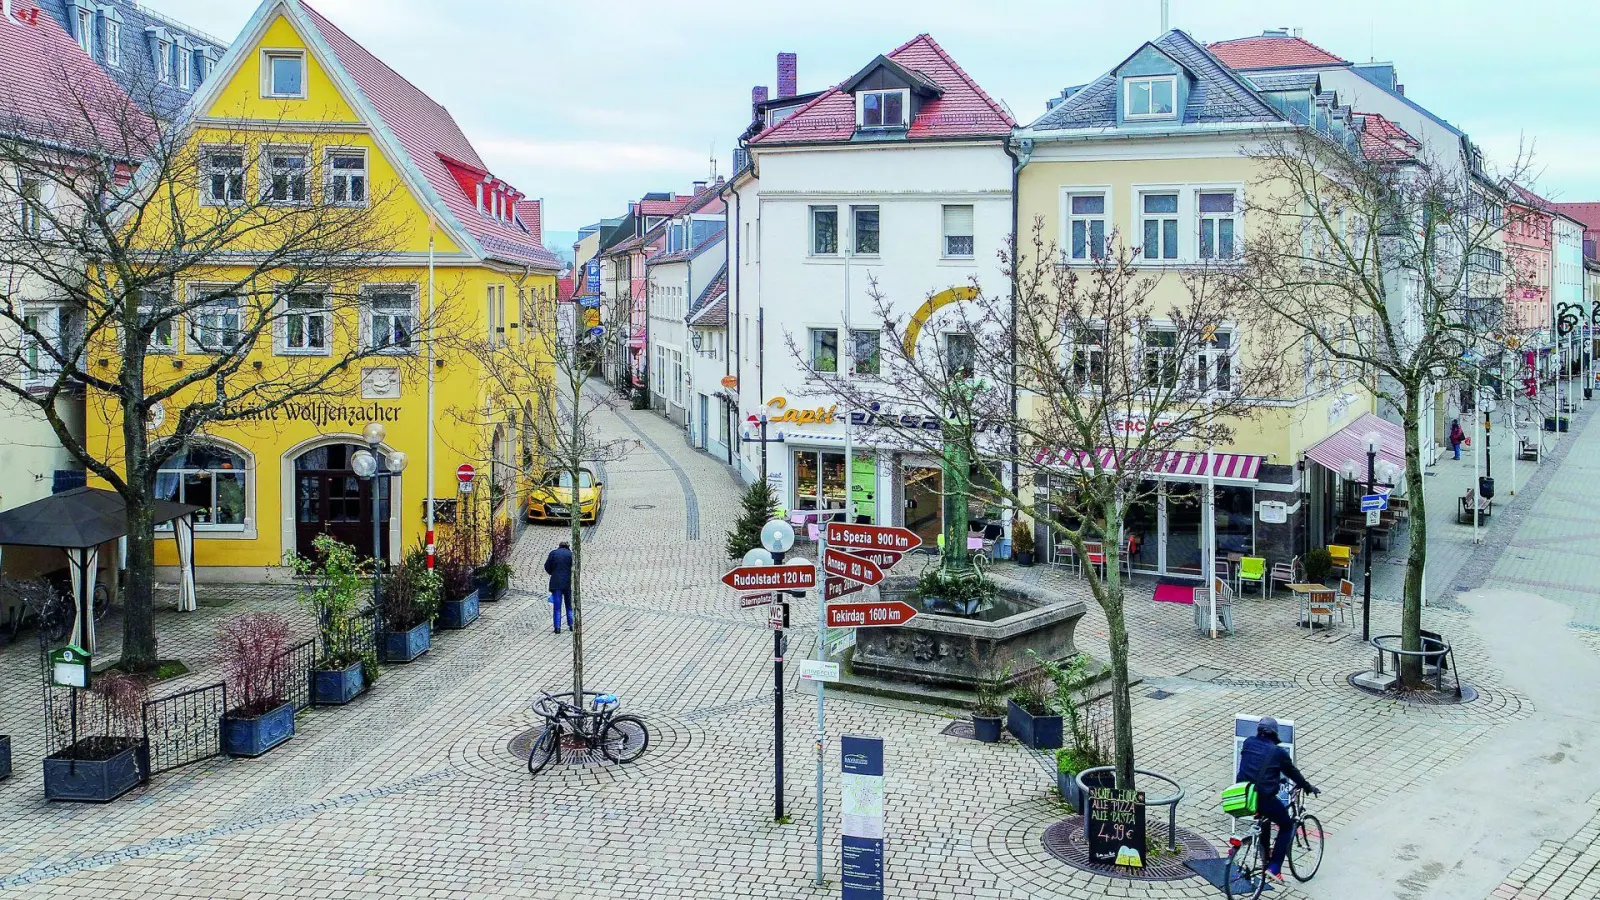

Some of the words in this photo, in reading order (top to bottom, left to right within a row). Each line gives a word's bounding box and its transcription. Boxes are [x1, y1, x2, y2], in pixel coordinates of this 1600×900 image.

[766, 396, 840, 427] Capri
[831, 528, 841, 541] La
[843, 529, 872, 544] Spezia
[877, 532, 893, 546] 900
[895, 534, 908, 547] km
[883, 553, 894, 565] km
[827, 555, 847, 574] Annecy
[851, 562, 861, 576] 820
[863, 566, 873, 580] km
[733, 572, 781, 586] Rudolstadt
[782, 571, 797, 584] 120
[799, 571, 812, 583] km
[829, 582, 842, 596] Prag
[769, 605, 782, 619] WC
[831, 609, 865, 624] Tekirdag
[868, 607, 886, 621] 1600
[888, 607, 901, 620] km
[1092, 799, 1109, 810] ALLE
[1111, 800, 1136, 813] PIZZA
[1110, 811, 1136, 825] PASTA
